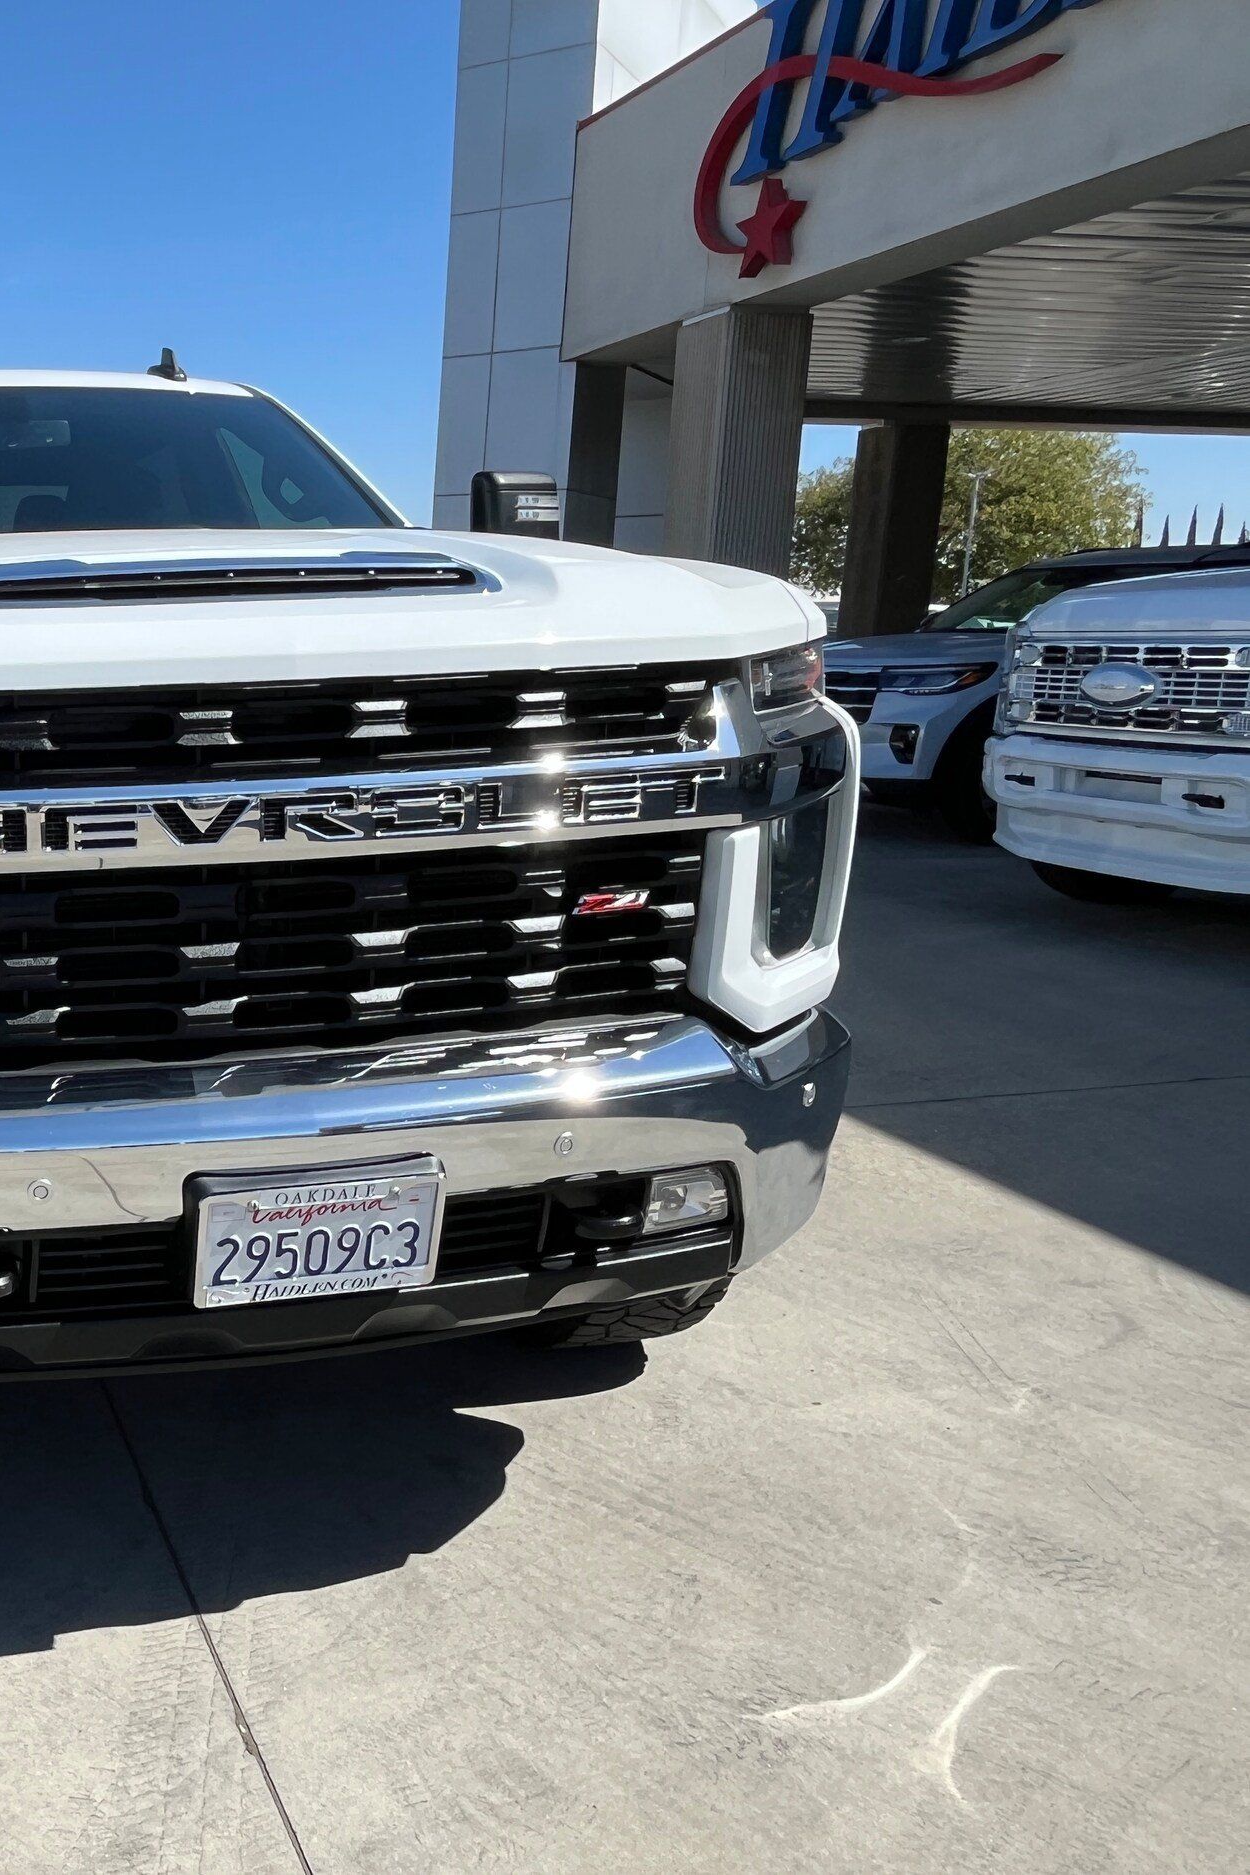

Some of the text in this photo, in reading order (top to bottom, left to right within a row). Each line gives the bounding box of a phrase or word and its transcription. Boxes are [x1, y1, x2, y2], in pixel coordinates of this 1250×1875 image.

[572, 889, 650, 915] Z71
[275, 1183, 377, 1206] OAKDALE
[252, 1197, 397, 1227] California
[211, 1220, 421, 1287] 29509C3
